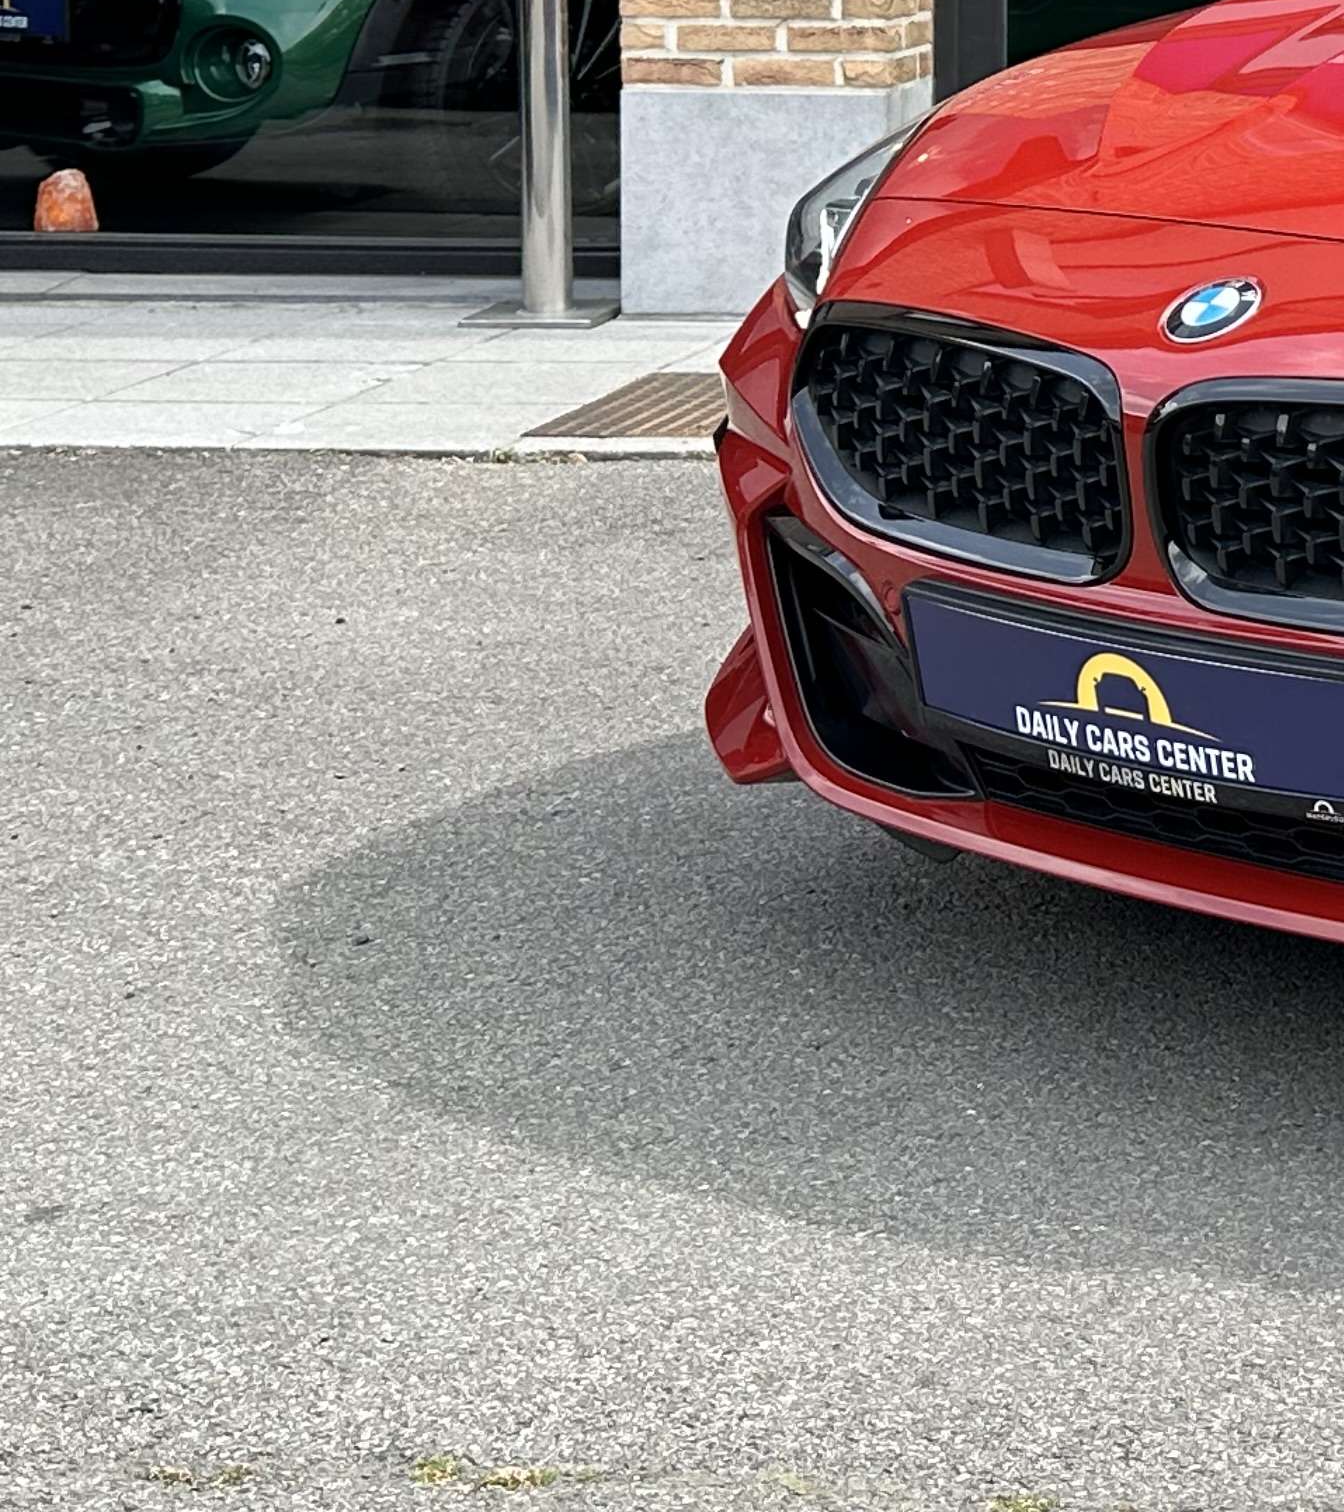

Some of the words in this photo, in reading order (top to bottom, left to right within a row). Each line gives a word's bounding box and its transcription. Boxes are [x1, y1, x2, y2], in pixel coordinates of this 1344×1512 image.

[1015, 705, 1080, 748] DAILY
[1085, 723, 1151, 763] CARS
[1156, 738, 1257, 784] CENTER
[1048, 748, 1095, 779] DAILY
[1099, 762, 1146, 790] CARS
[1149, 772, 1219, 805] CENTER
